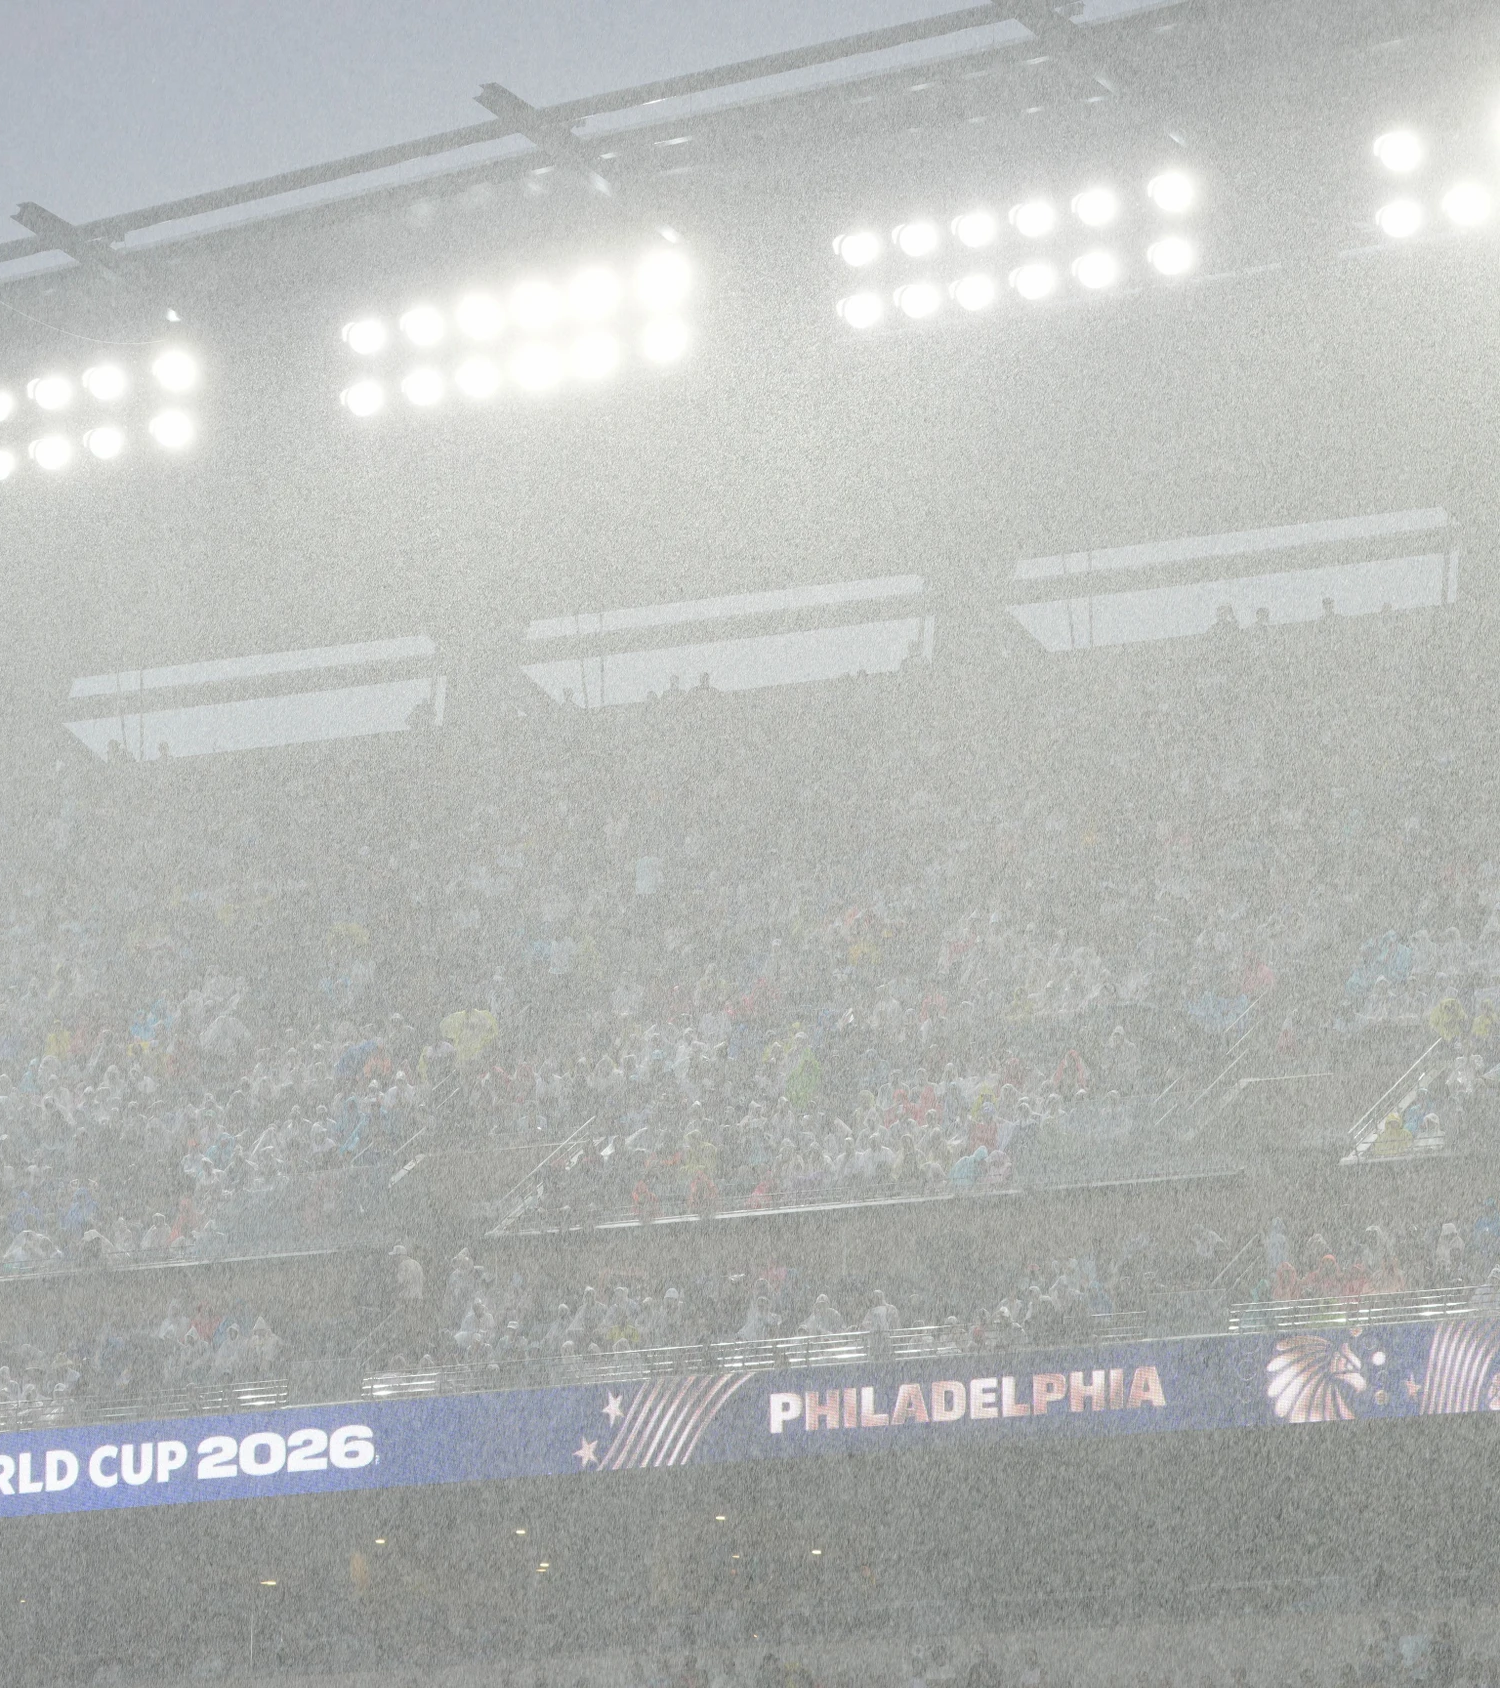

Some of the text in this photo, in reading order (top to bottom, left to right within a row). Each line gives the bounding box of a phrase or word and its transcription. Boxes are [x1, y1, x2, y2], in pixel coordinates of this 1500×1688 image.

[769, 1366, 1166, 1434] PHILADELPHIA
[88, 1440, 188, 1488] CUP
[197, 1425, 375, 1480] 2026
